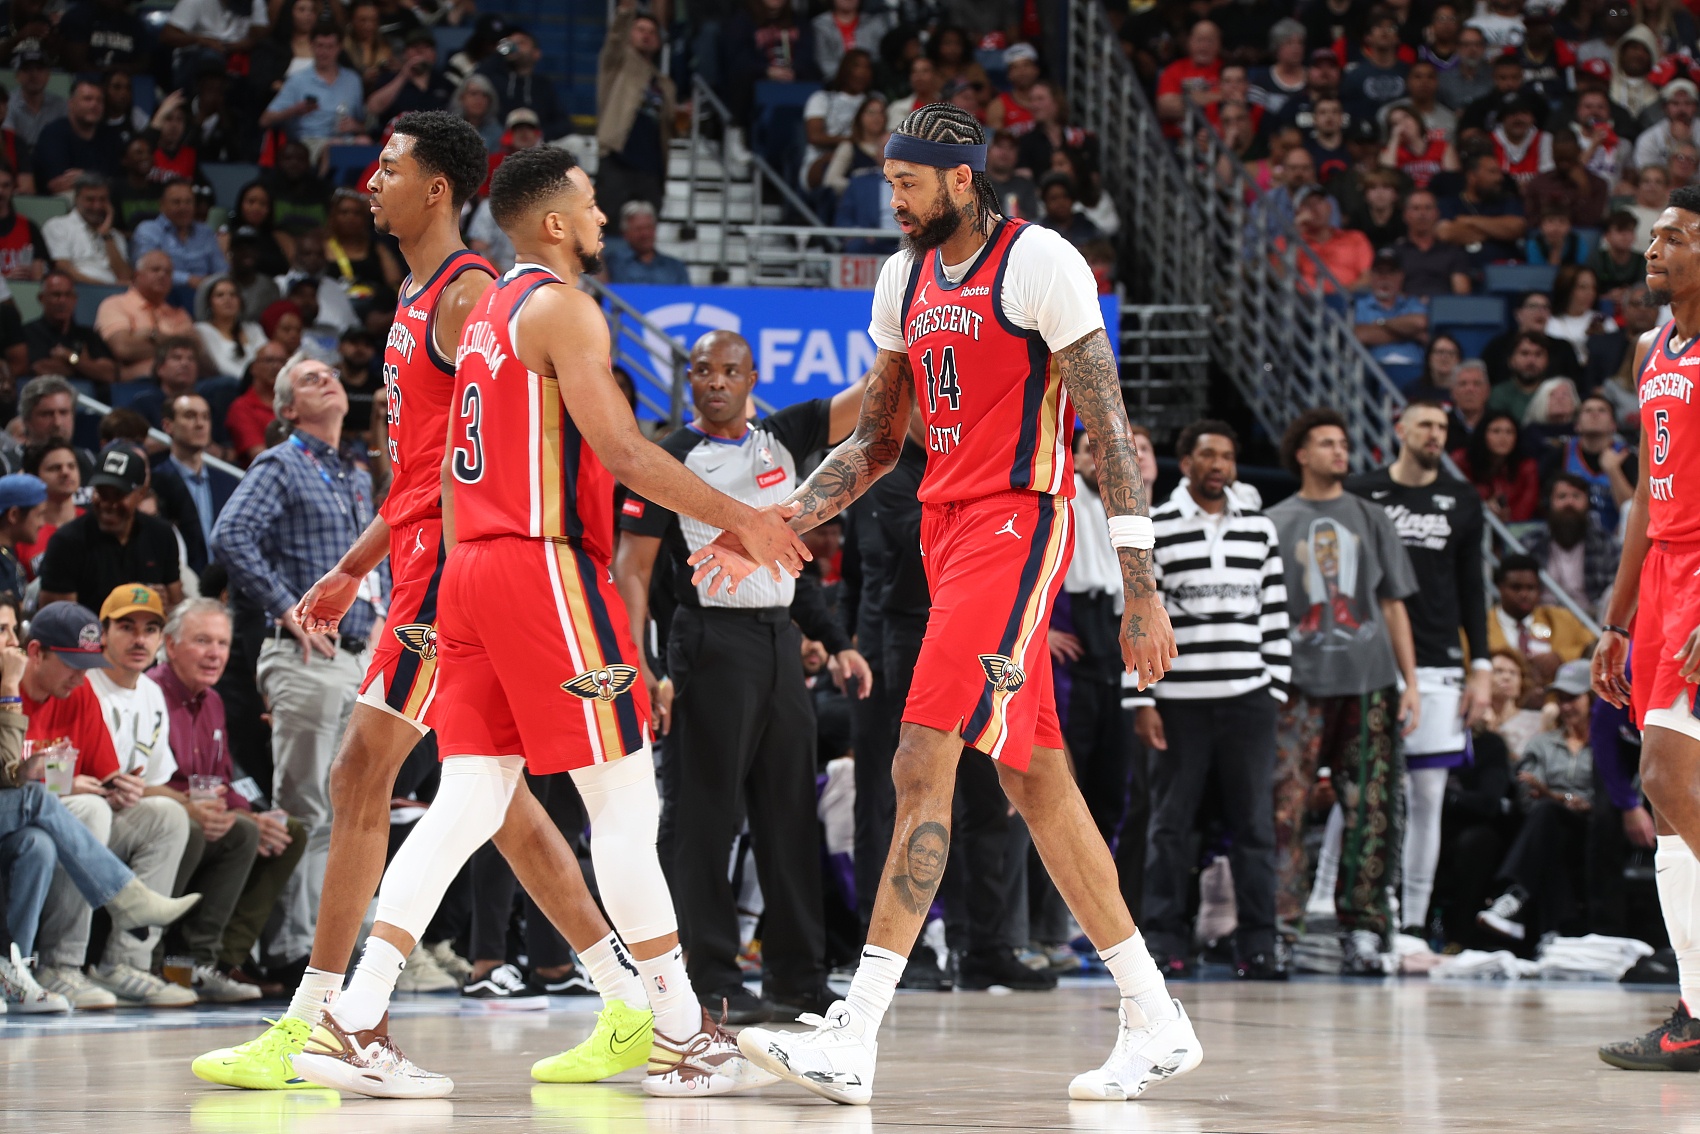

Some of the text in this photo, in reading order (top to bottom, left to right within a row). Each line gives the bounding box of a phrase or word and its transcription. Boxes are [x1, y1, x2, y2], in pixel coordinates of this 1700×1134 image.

[840, 256, 877, 288] EXIT
[960, 286, 990, 298] ibotta
[407, 305, 428, 322] ibotta
[907, 304, 984, 349] CRESCENT
[382, 362, 402, 426] 25
[921, 345, 962, 414] 14
[1639, 372, 1695, 409] CRESCENT
[451, 382, 485, 485] 3
[929, 422, 963, 455] CITY
[1653, 409, 1671, 466] 5
[1649, 473, 1675, 501] CITY
